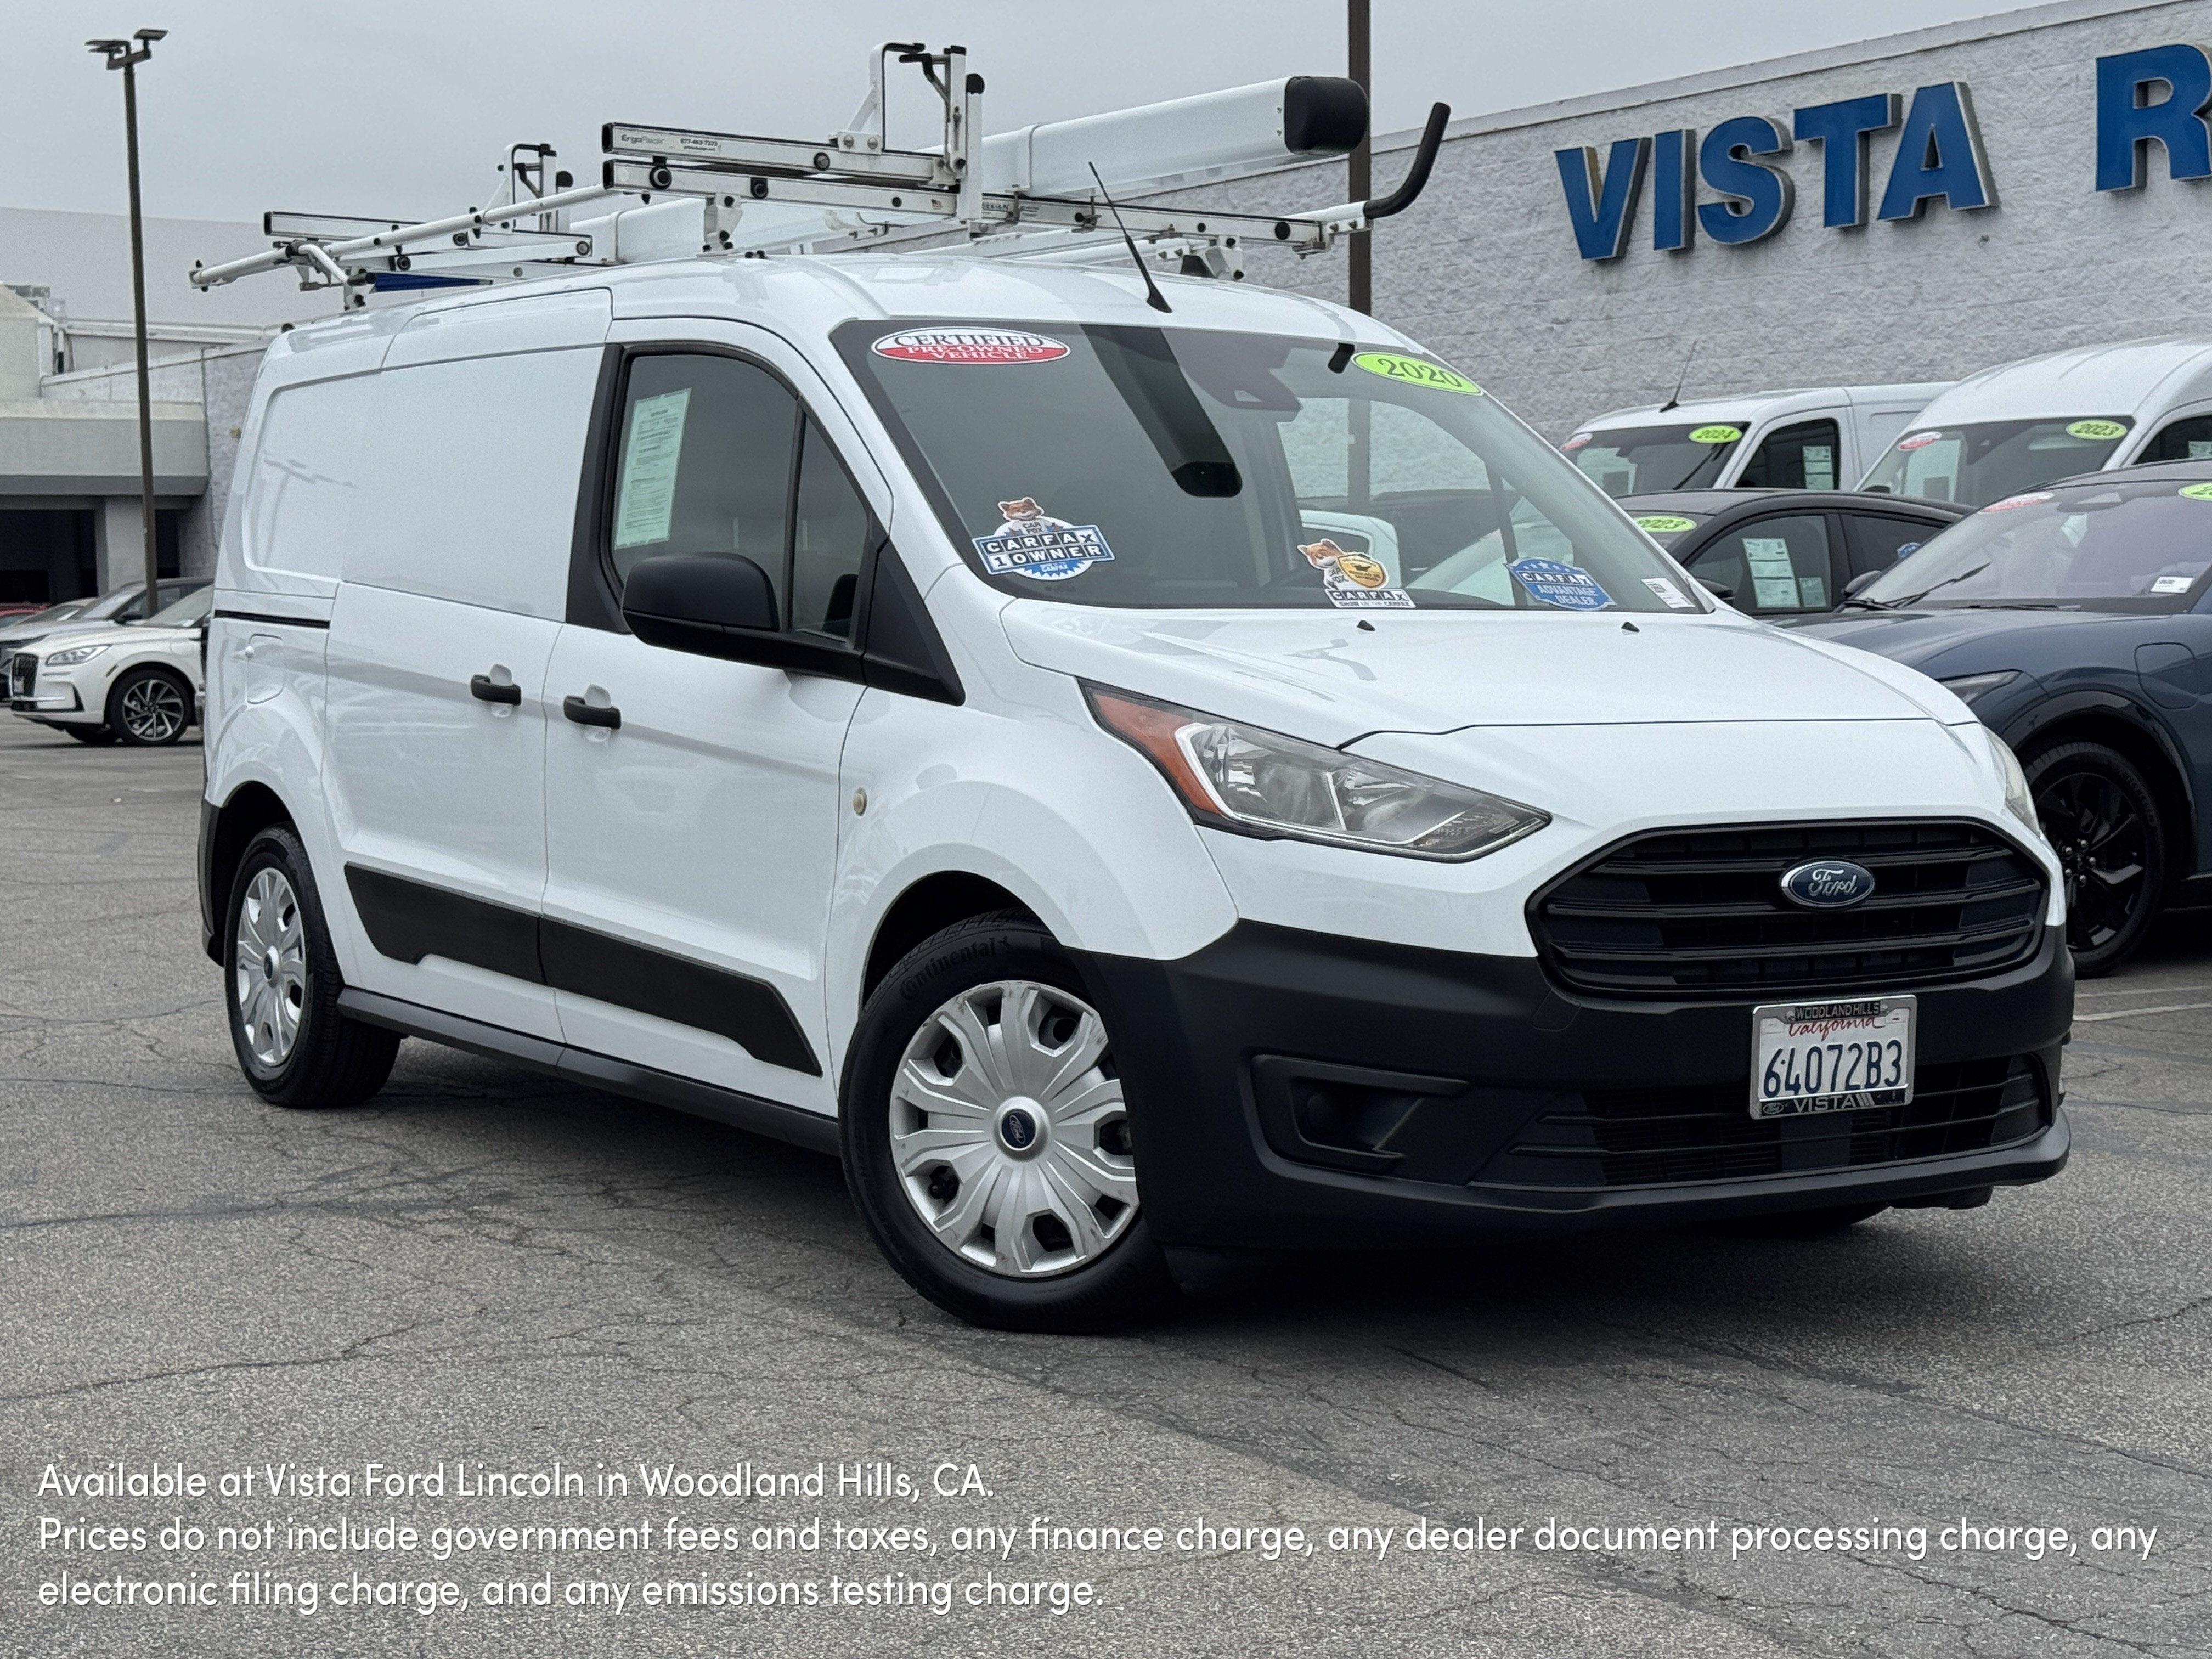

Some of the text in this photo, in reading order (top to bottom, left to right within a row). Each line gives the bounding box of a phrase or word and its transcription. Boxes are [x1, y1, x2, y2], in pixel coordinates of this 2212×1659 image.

[1554, 81, 1995, 261] VISTA
[894, 334, 1044, 347] CERTIFIED
[905, 345, 1043, 354] PRE-OWNED
[930, 351, 1029, 359] VEHICLE
[1377, 358, 1463, 388] 2020
[2074, 423, 2120, 436] 2023
[987, 533, 1097, 552] CARFAX
[994, 546, 1102, 567] 1 OWNER
[1521, 573, 1594, 586] CARFAX
[1333, 590, 1409, 601] CARFAX
[1536, 585, 1599, 597] ADVANTAGE
[1555, 595, 1598, 606] DEALER
[1808, 868, 1858, 897] Ford
[900, 936, 996, 1000] Continental
[1797, 1002, 1880, 1019] WOODLAND HILLS
[1789, 1017, 1886, 1041] California
[1763, 1040, 1902, 1098] 64072B3
[1793, 1094, 1860, 1113] VISTA
